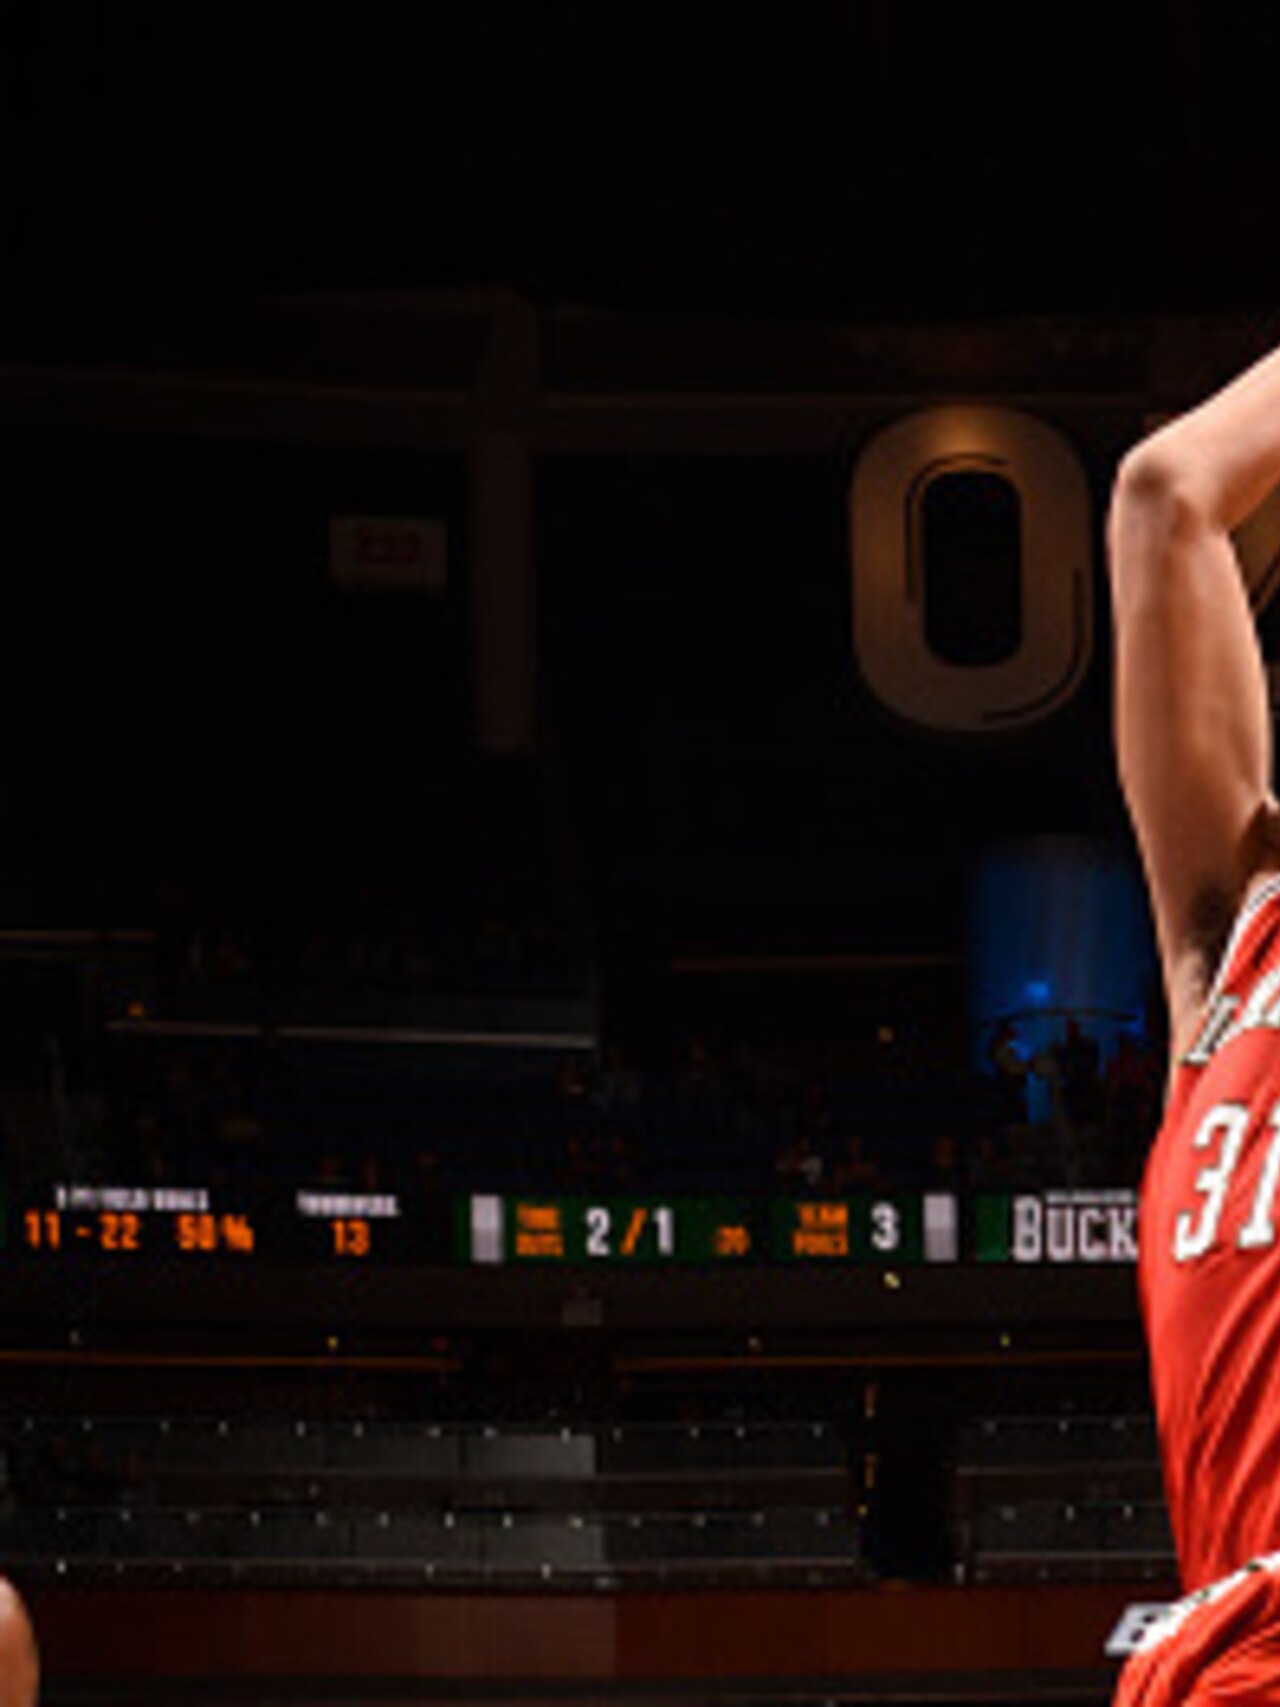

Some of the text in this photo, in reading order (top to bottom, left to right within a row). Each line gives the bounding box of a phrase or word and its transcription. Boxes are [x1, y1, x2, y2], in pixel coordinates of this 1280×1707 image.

[332, 1218, 370, 1257] 13
[871, 1202, 899, 1250] 3
[1012, 1194, 1139, 1262] BUCK
